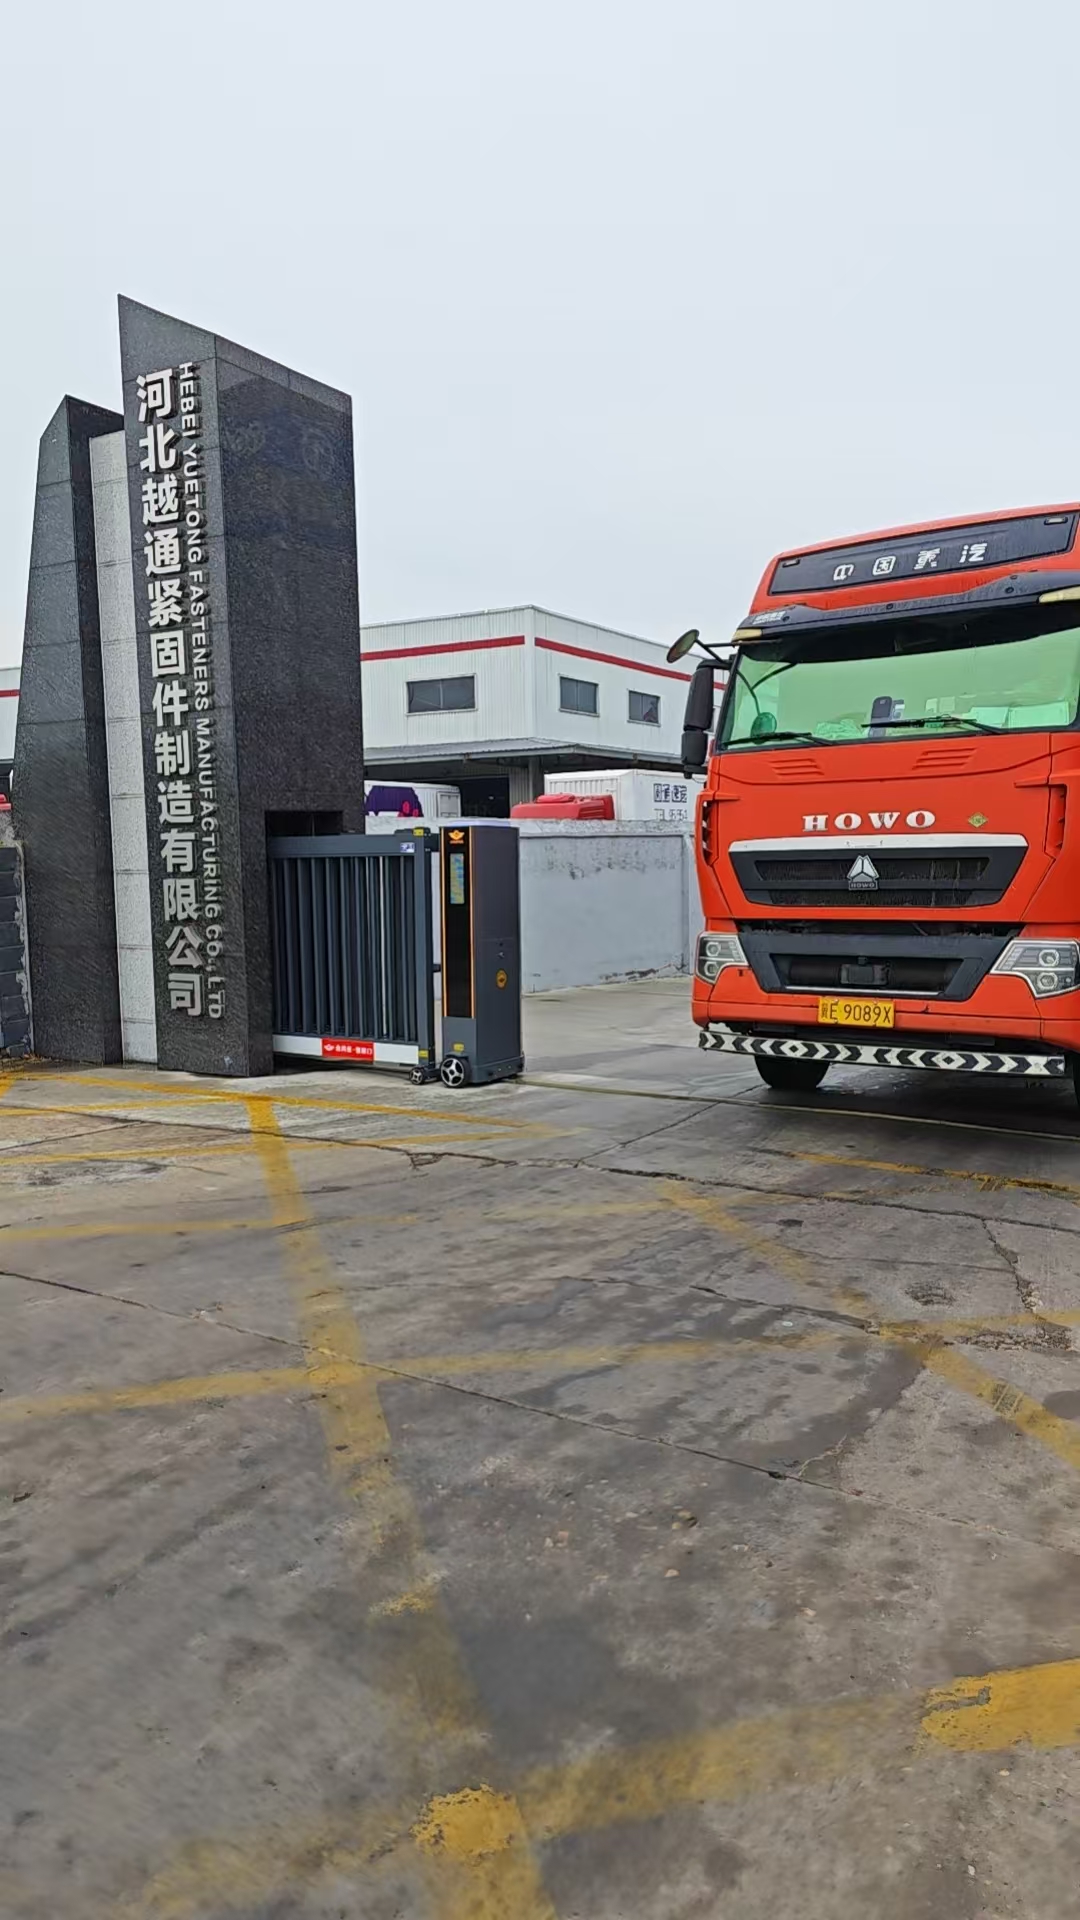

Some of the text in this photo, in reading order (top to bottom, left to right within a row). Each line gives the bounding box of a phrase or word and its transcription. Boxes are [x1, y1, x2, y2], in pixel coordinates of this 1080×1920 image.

[179, 361, 198, 438] HEBEI
[183, 442, 202, 563] YUETONG
[136, 368, 204, 1018] 河北越通紧固件制造有限公司
[188, 570, 209, 711] FASTENERS
[196, 718, 221, 919] MANUFACTURING
[802, 810, 936, 832] HOWO
